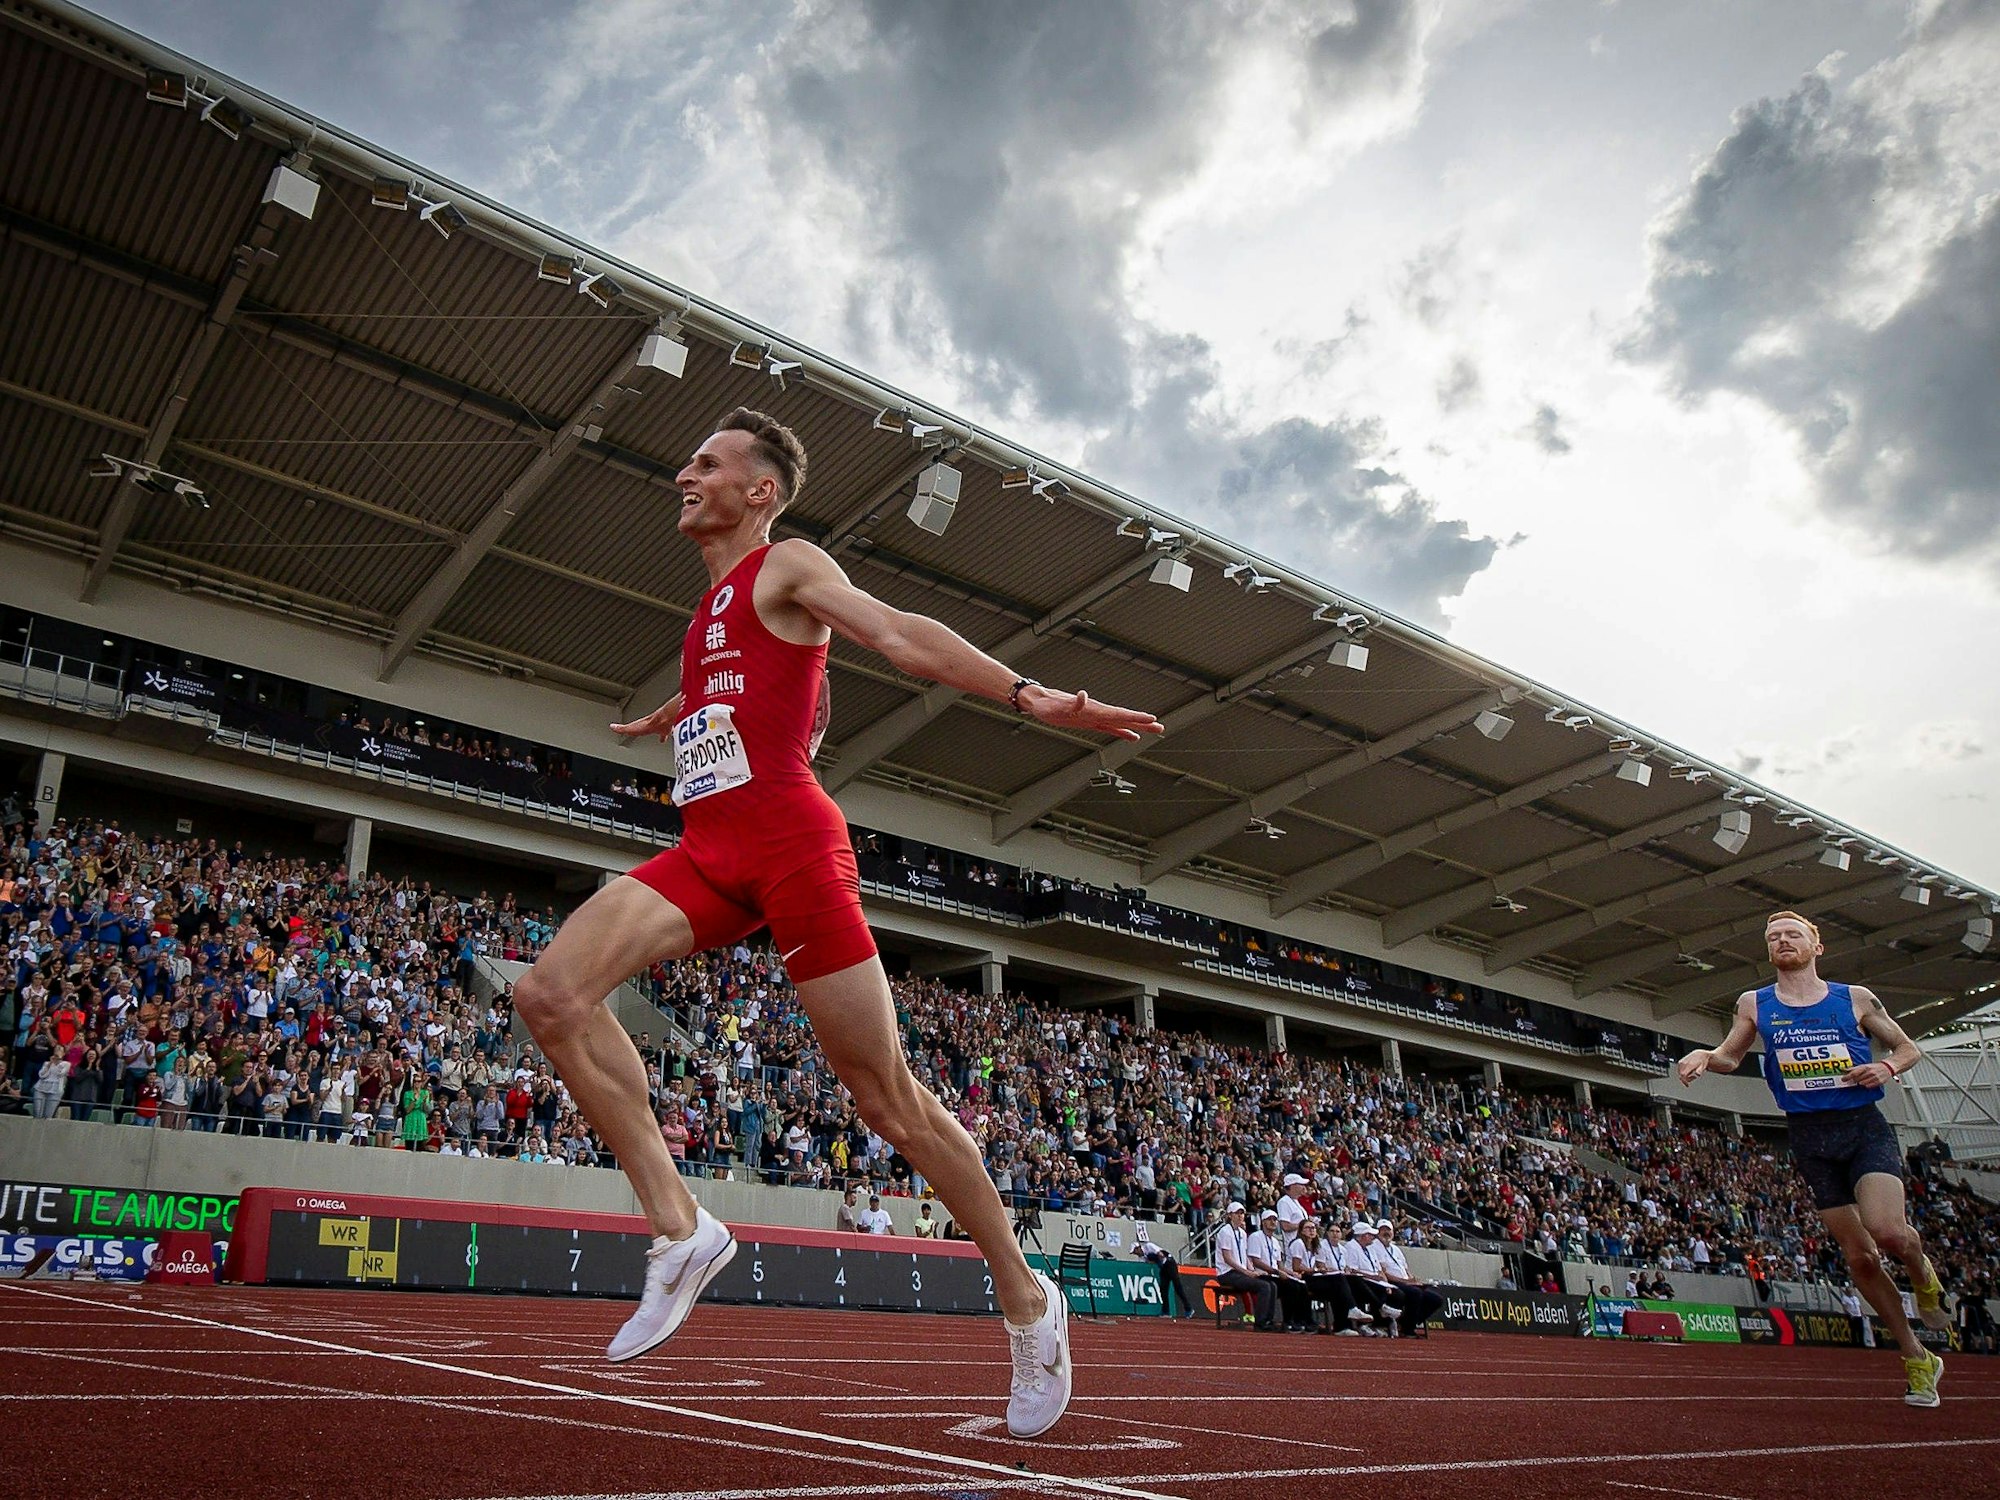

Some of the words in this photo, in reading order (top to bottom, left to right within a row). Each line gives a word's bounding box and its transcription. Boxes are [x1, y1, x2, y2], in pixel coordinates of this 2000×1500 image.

[42, 785, 54, 801] B
[1782, 1060, 1850, 1077] RUPPERT
[309, 1198, 347, 1211] OMEGA
[332, 1224, 358, 1242] WR
[1066, 1219, 1091, 1240] Tor
[1096, 1221, 1106, 1241] B
[166, 1262, 210, 1273] OMEGA
[568, 1249, 582, 1273] 7
[753, 1262, 764, 1283] 5
[834, 1267, 846, 1287] 4
[912, 1271, 922, 1292] 3
[984, 1275, 994, 1295] 2
[1444, 1297, 1478, 1319] Jetzt
[1480, 1299, 1503, 1321] DLV
[1508, 1301, 1531, 1326] App
[1532, 1301, 1570, 1325] laden!
[1688, 1312, 1737, 1333] SACHSEN
